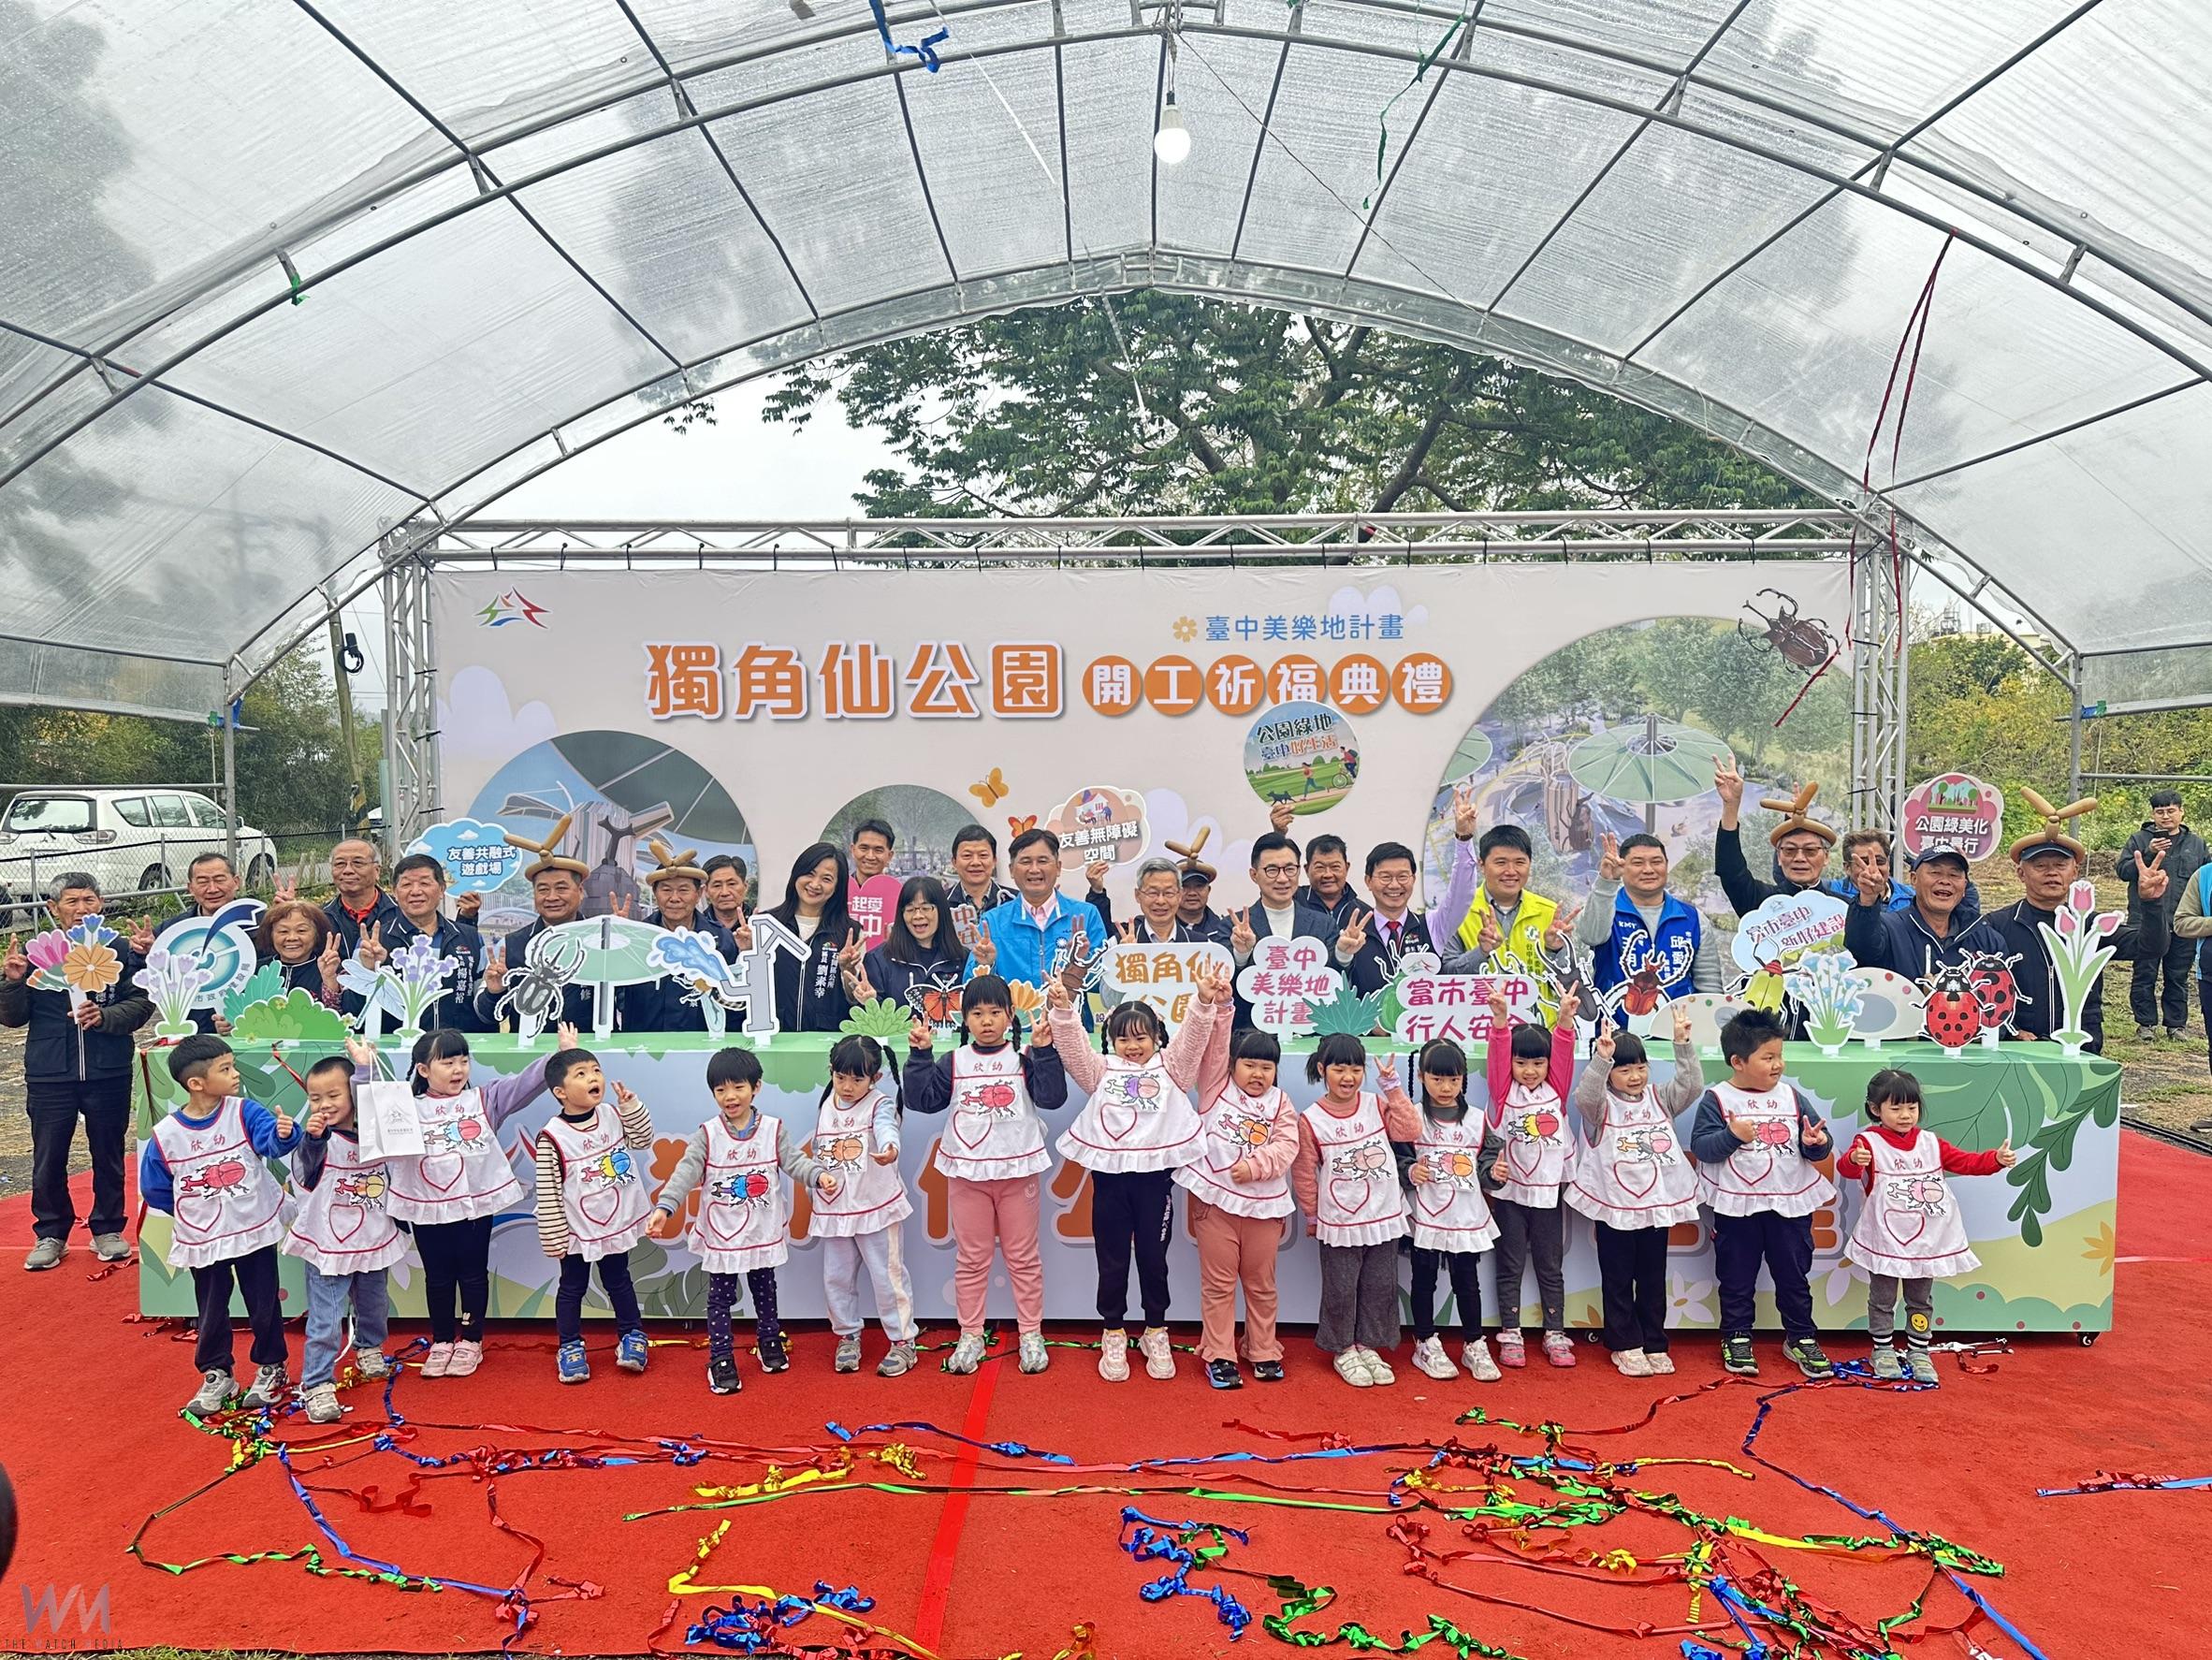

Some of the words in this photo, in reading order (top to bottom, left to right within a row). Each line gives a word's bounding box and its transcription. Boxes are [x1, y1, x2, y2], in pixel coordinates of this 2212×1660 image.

[1205, 614, 1404, 641] 臺中美樂地計畫
[646, 643, 1061, 718] 獨角仙公園
[1092, 662, 1443, 706] 開工祈福典禮
[1257, 713, 1332, 742] 公園綠地
[1059, 821, 1138, 849] 友善無障礙
[1915, 816, 1988, 835] 公園綠美化
[448, 846, 516, 861] 友善共融式
[1084, 845, 1115, 865] 空間
[460, 862, 502, 876] 遊戲場
[847, 896, 882, 913] 起愛
[1265, 945, 1317, 970] 臺中
[1250, 972, 1331, 997] 美樂地
[1406, 978, 1528, 1006] 富市臺中
[1263, 999, 1313, 1025] 計畫
